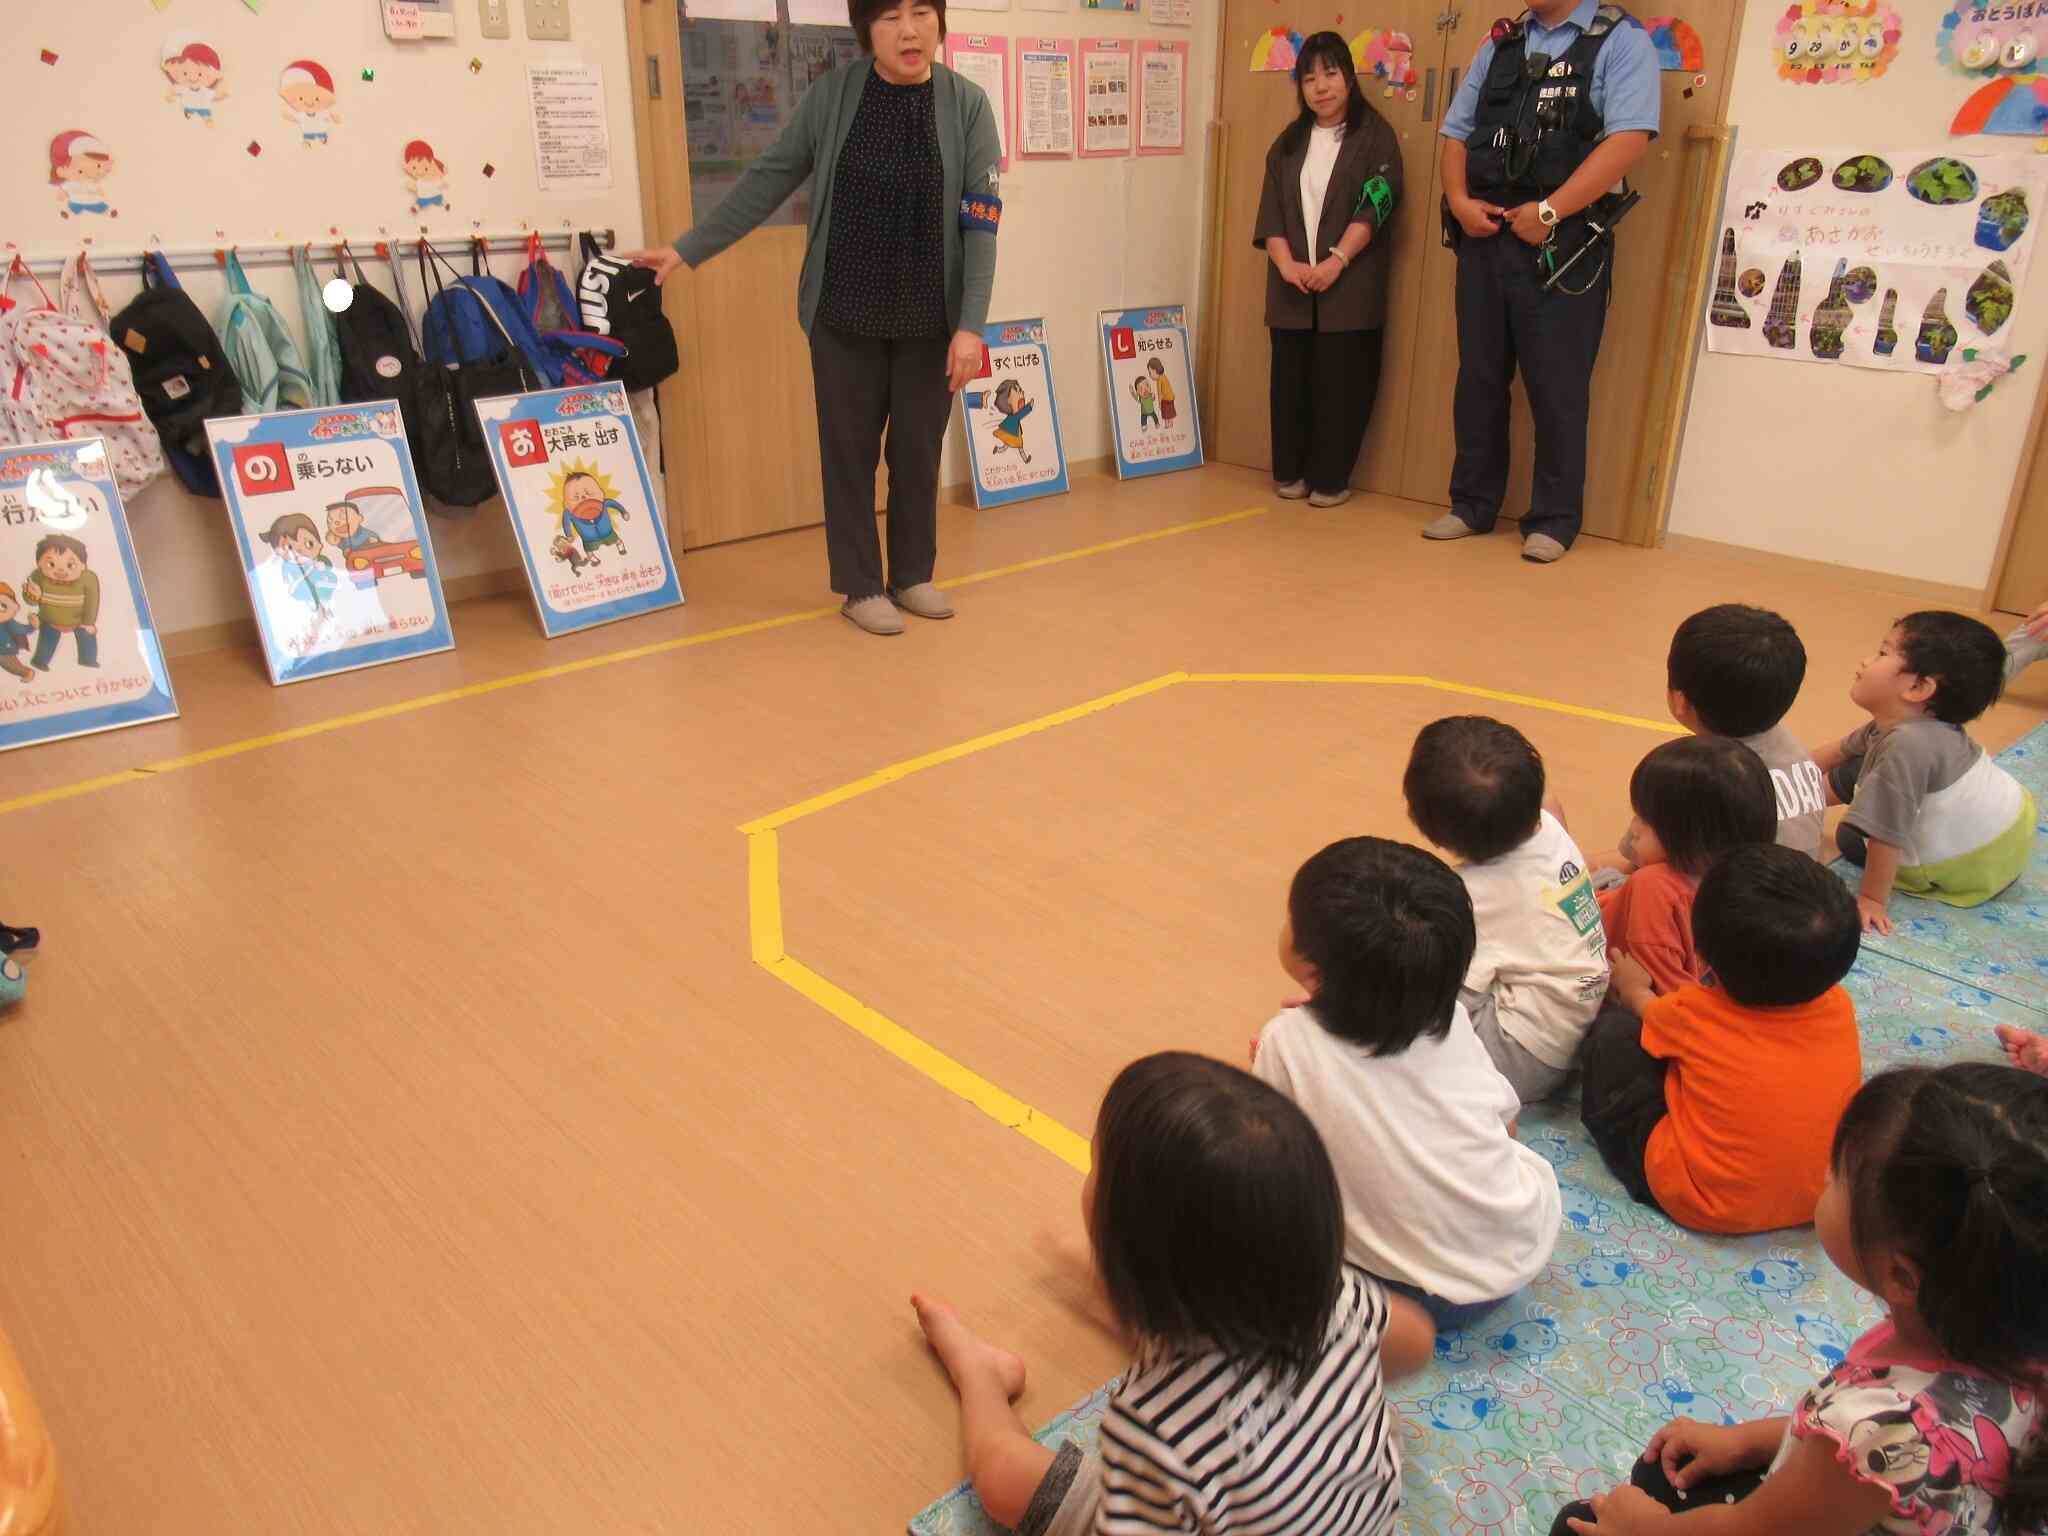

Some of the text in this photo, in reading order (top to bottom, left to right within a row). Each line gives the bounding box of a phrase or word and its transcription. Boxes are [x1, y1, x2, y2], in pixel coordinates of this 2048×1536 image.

[1788, 41, 1798, 55] 9
[509, 427, 537, 458] お
[244, 454, 281, 482] の
[296, 455, 375, 481] 乗らない
